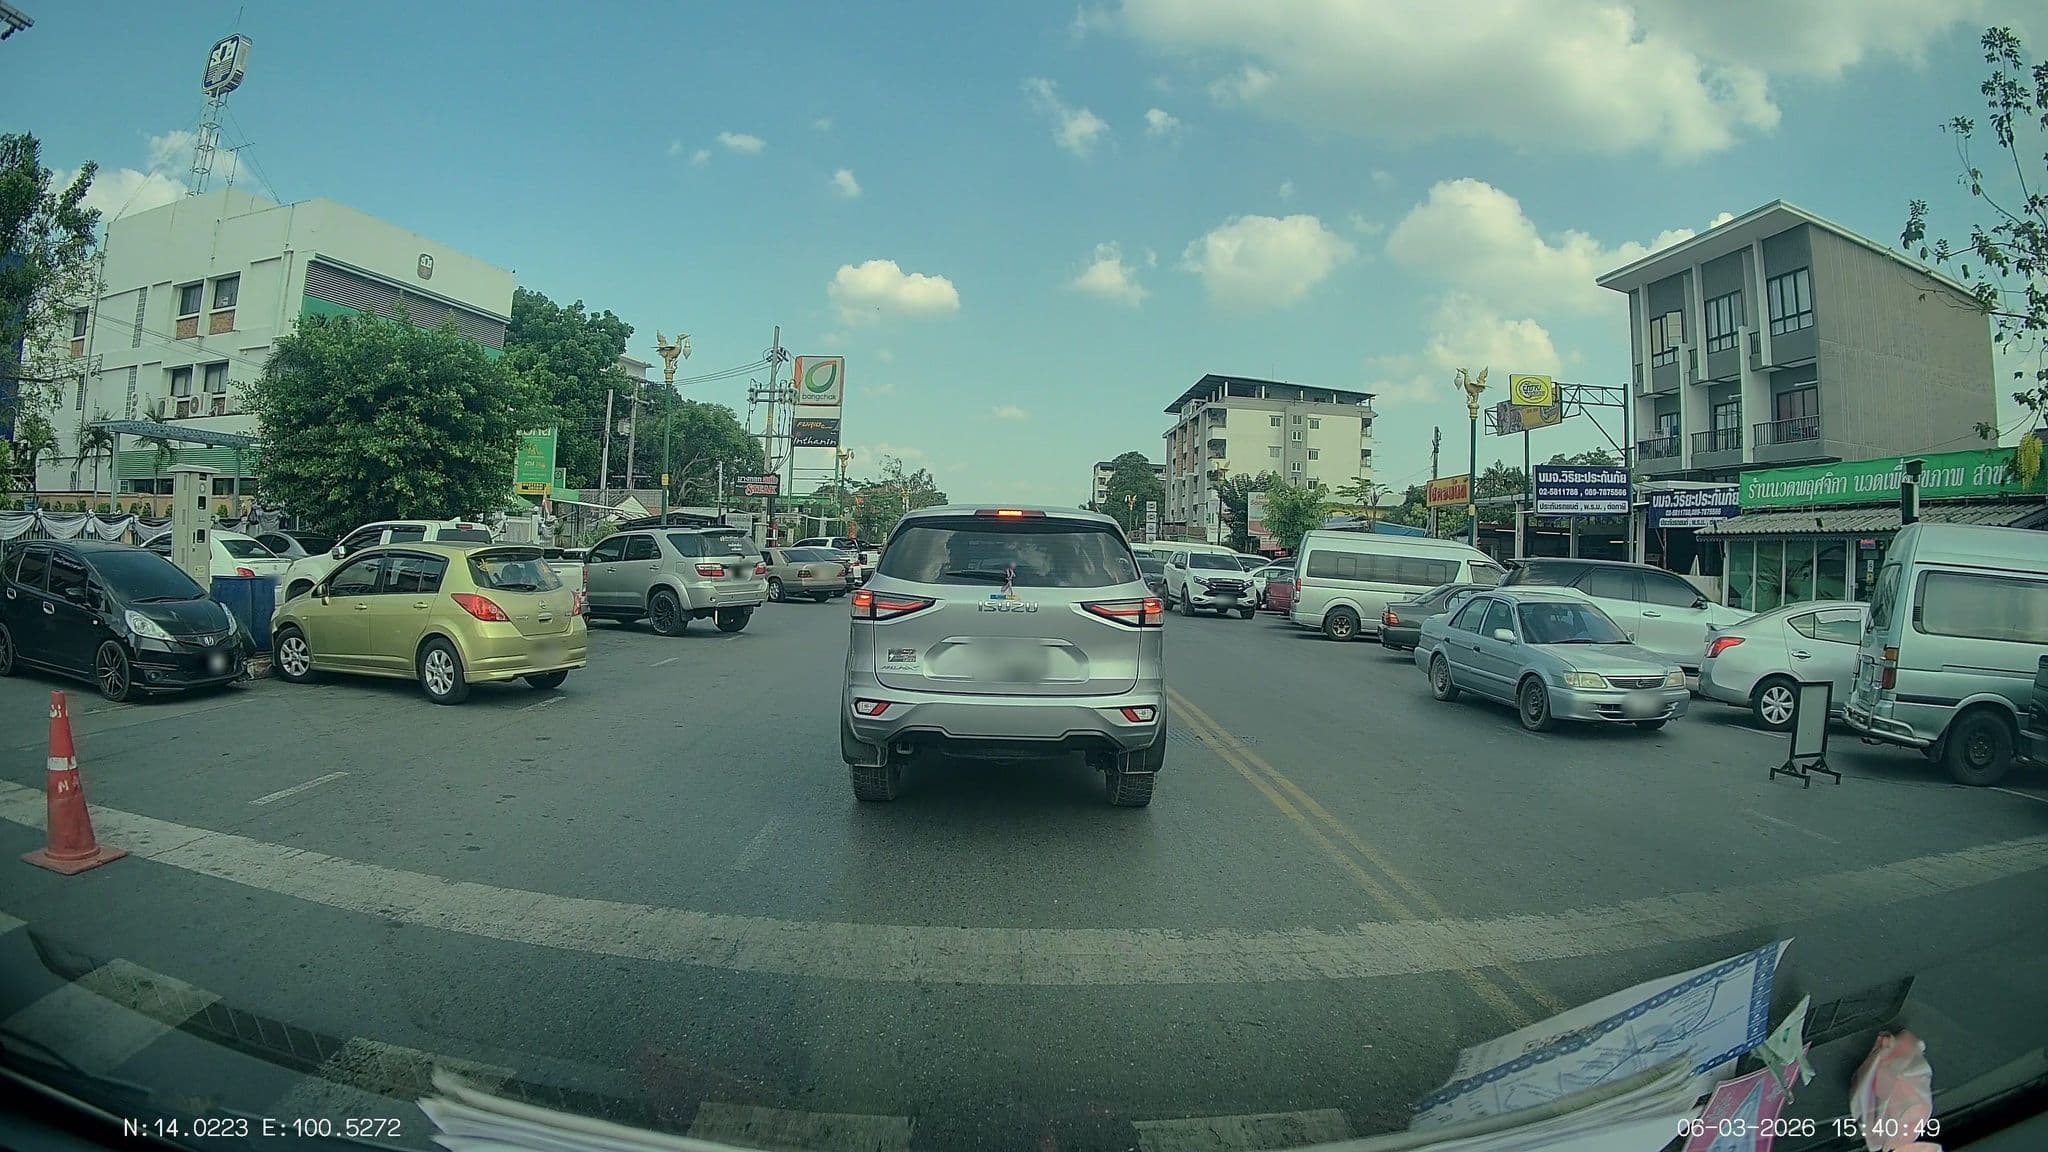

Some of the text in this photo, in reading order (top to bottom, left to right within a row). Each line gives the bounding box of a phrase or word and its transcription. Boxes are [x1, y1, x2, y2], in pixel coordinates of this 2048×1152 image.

[1538, 470, 1627, 484] บมจ.วิริยะประกันภัย
[1748, 471, 1848, 500] ร้านนวดพฤศจิกา
[1854, 459, 1965, 492] นวดเพื่ขภาพ
[1652, 488, 1739, 508] บมจ.วิริยะประกันภัย
[978, 600, 1038, 612] ISUZU
